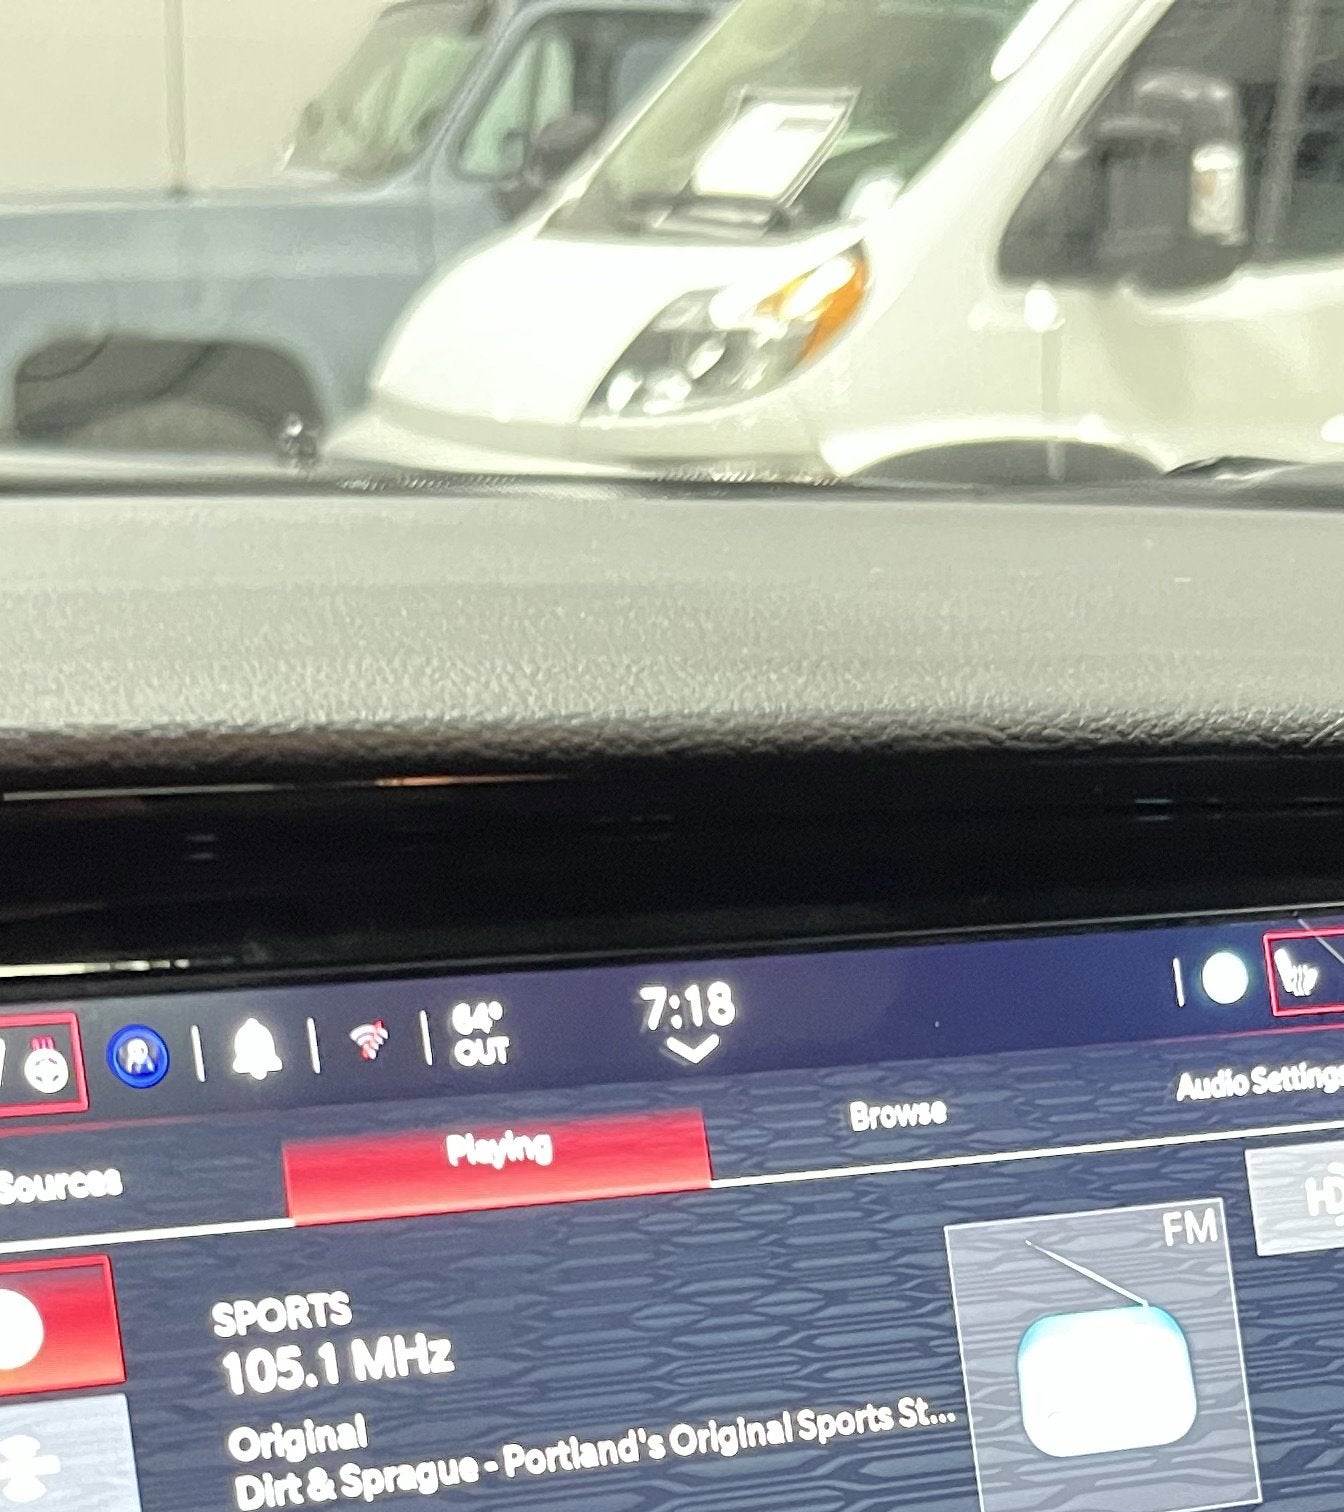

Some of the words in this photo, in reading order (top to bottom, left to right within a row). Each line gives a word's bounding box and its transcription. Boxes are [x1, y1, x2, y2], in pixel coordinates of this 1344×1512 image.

[639, 980, 737, 1031] 7:18
[453, 1035, 510, 1067] OUT
[1175, 1068, 1250, 1102] Audio
[849, 1096, 948, 1133] Browse
[446, 1129, 553, 1170] Playing
[1162, 1206, 1219, 1247] FM
[211, 1290, 353, 1338] SPORTS
[221, 1340, 340, 1396] 105.1
[350, 1332, 456, 1382] MHz
[227, 1412, 369, 1463] Original
[234, 1471, 305, 1512] Dirt
[306, 1466, 338, 1503] &
[339, 1456, 480, 1502] Sprague
[502, 1427, 667, 1478] Portland's
[668, 1410, 795, 1458] Original
[796, 1402, 893, 1445] Sports
